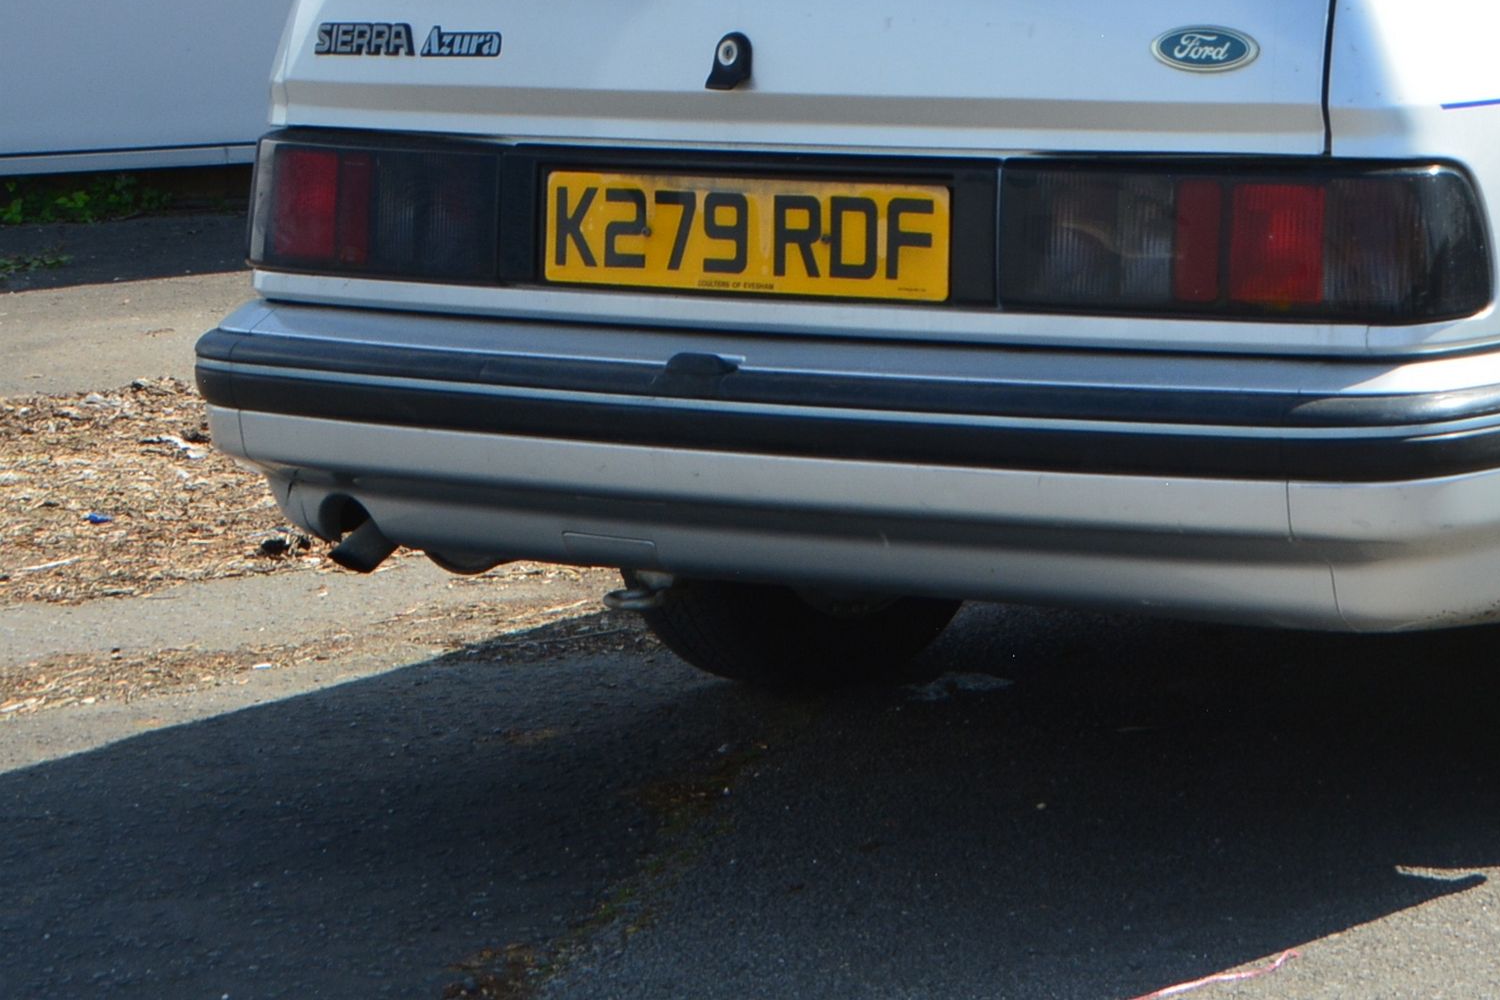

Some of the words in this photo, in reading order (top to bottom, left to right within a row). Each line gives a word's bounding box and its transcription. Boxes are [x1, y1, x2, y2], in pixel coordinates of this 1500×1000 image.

[315, 22, 415, 56] SIERRA
[420, 25, 502, 57] Azura
[1174, 33, 1230, 60] Ford
[555, 186, 748, 274] K279
[773, 194, 934, 280] RDF
[732, 281, 742, 289] OF
